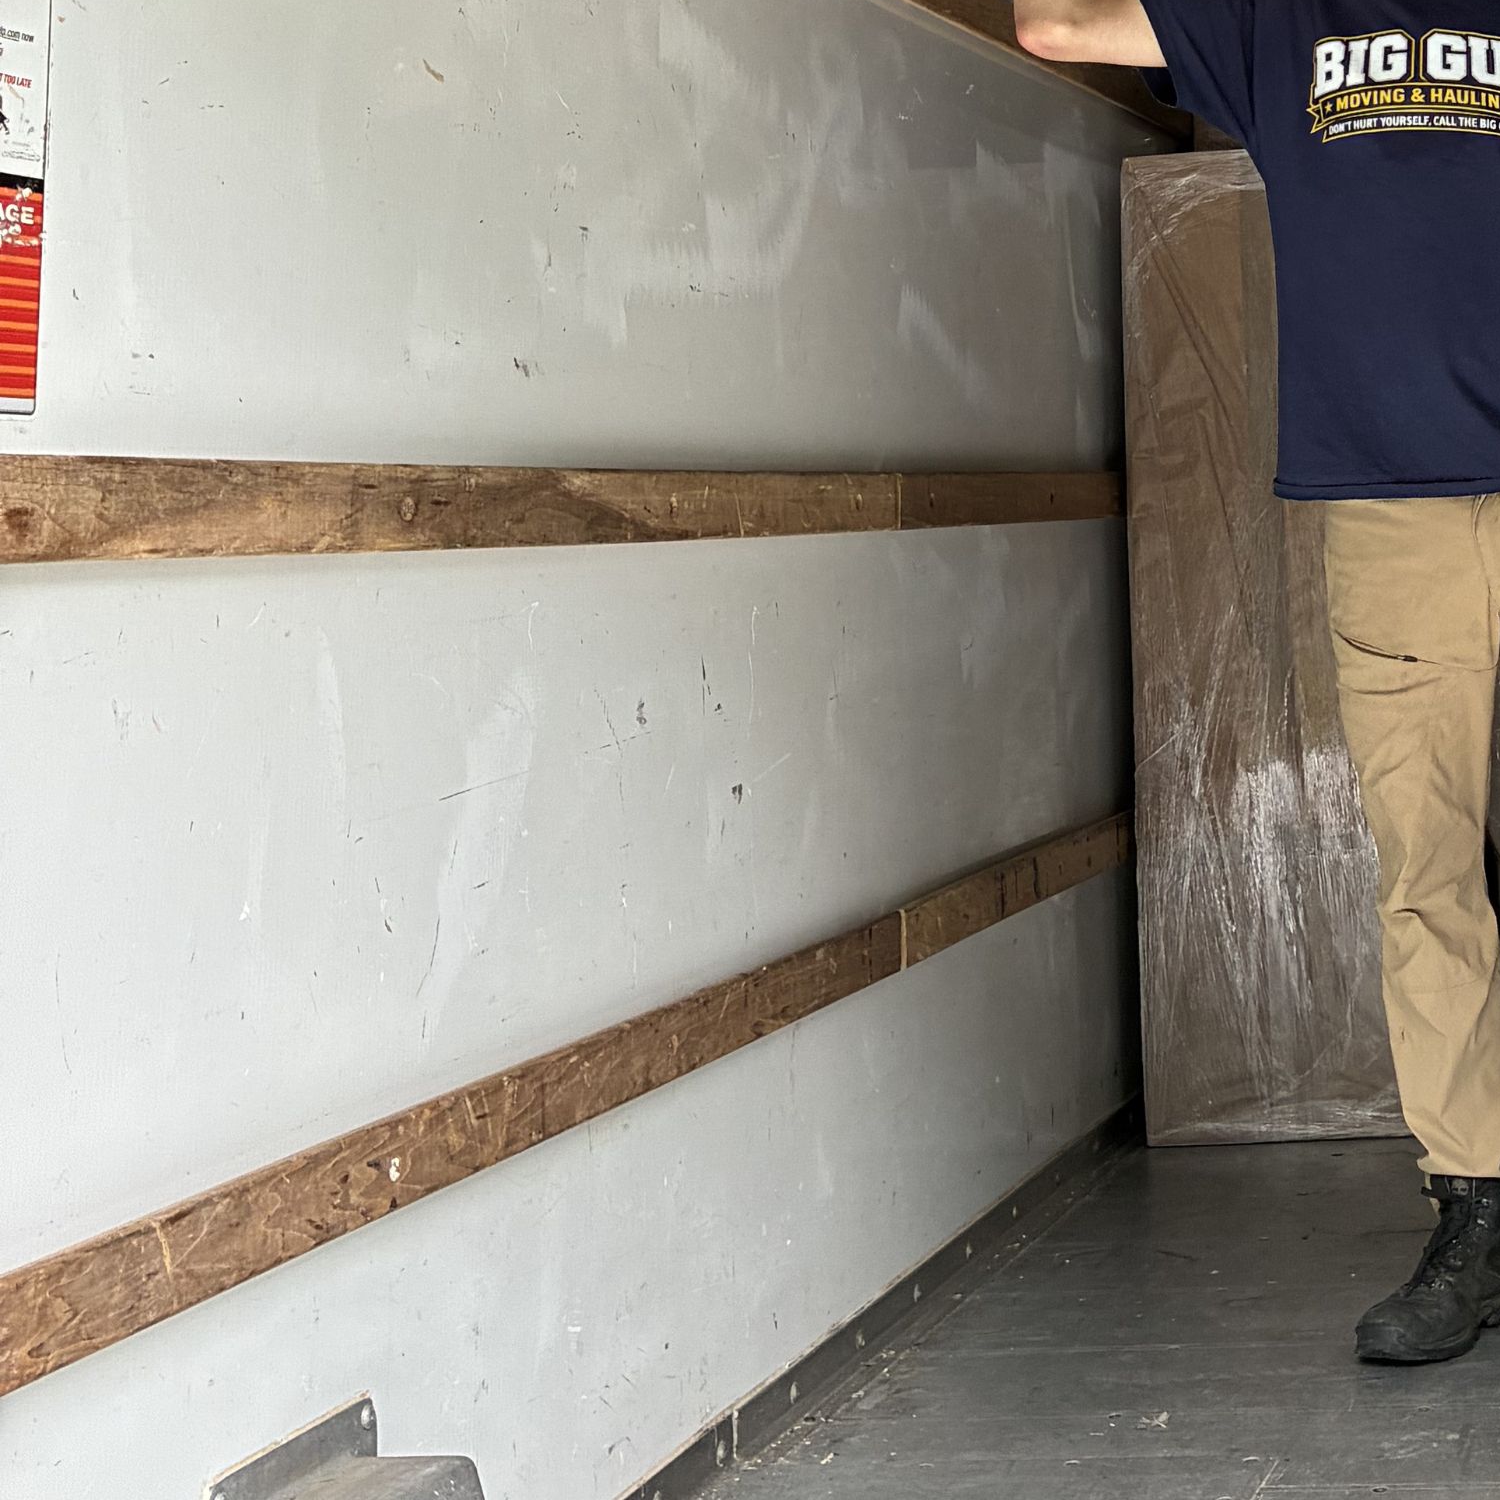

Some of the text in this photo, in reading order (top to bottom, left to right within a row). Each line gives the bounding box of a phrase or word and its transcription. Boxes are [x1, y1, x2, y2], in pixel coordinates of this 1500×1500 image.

[1314, 33, 1408, 99] BIG
[17, 77, 32, 89] LATE
[1336, 88, 1405, 112] MOVING
[1410, 88, 1425, 102] &
[1353, 117, 1379, 130] HURT
[1433, 116, 1457, 127] CALL
[1458, 117, 1478, 128] THE
[1480, 118, 1497, 130] BIG
